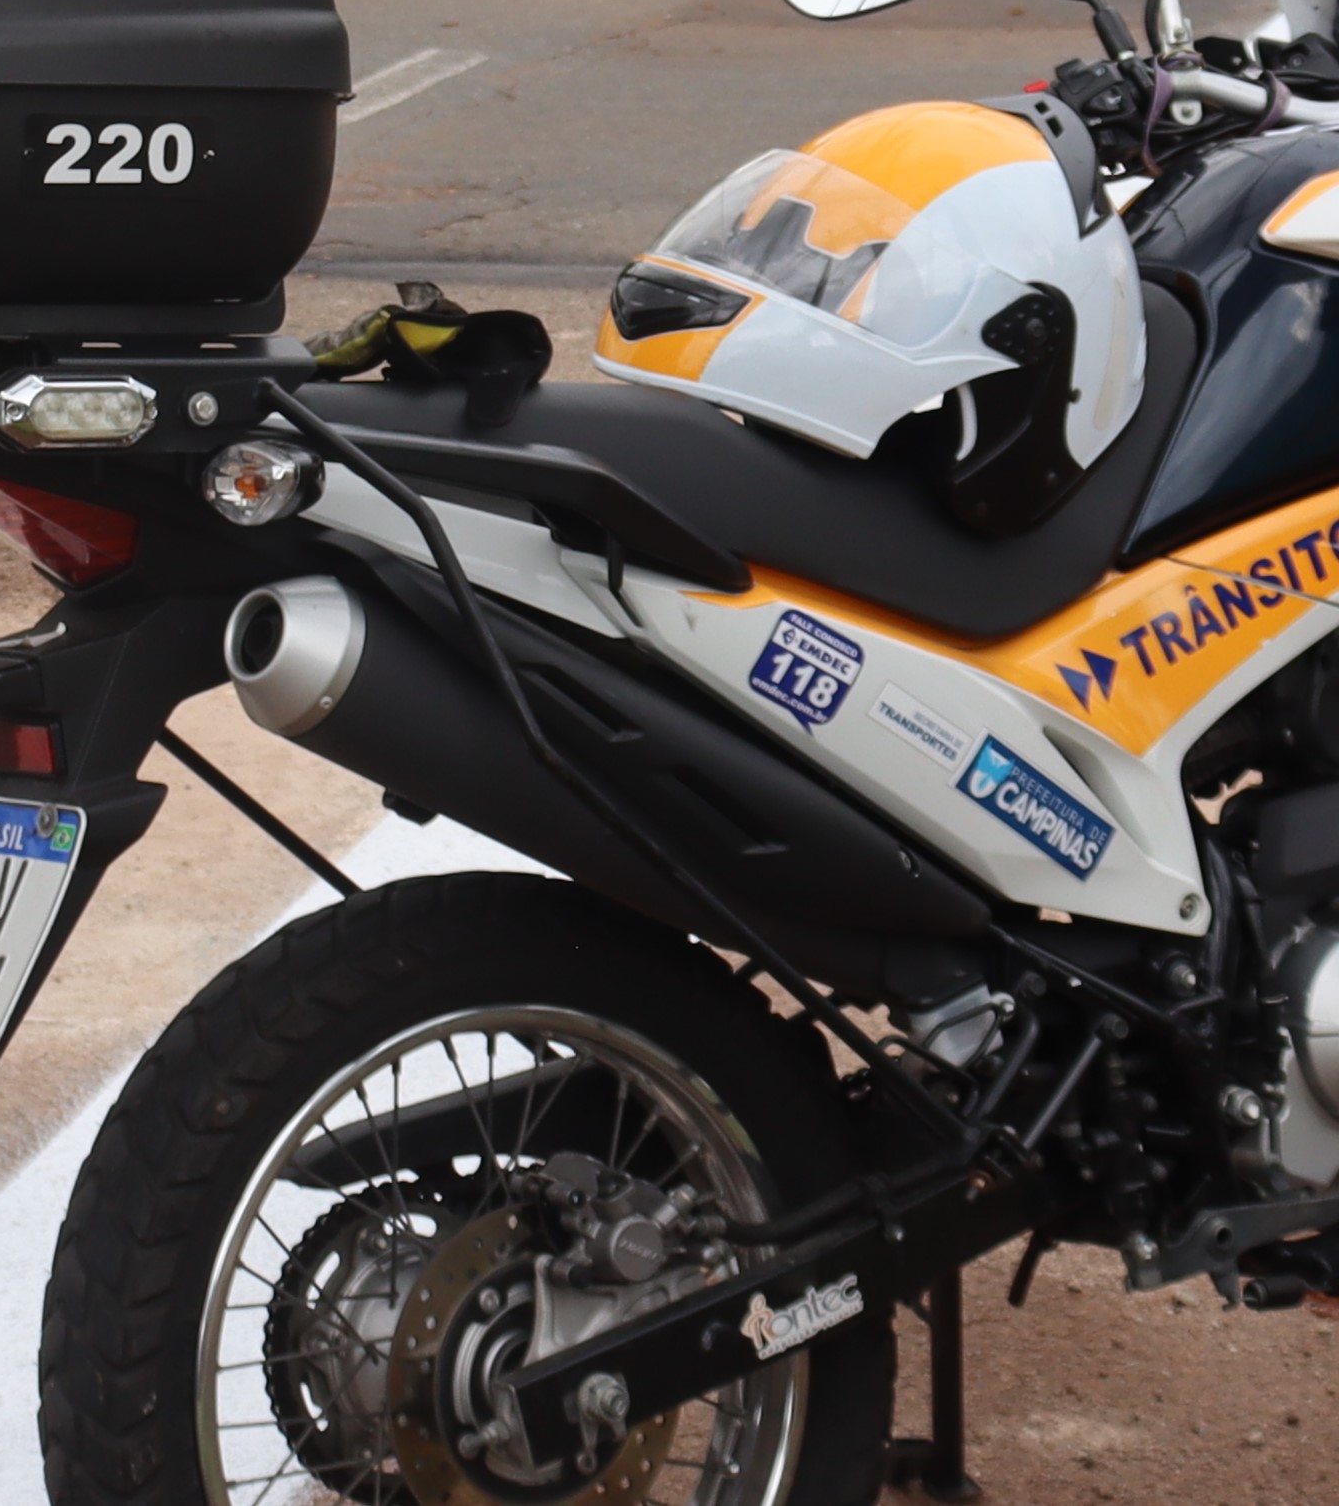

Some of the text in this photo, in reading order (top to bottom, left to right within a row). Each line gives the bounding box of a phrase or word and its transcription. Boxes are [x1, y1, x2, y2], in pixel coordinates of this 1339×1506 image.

[43, 122, 194, 184] 220
[1119, 519, 1339, 678] TRÂNSIT
[772, 652, 839, 709] 118
[798, 638, 851, 676] EMDEC
[751, 677, 828, 722] emdec.com.br
[879, 701, 958, 762] TRANSPORTES
[995, 780, 1099, 870] CAMPINAS
[1011, 765, 1108, 846] PREFEITURA DE
